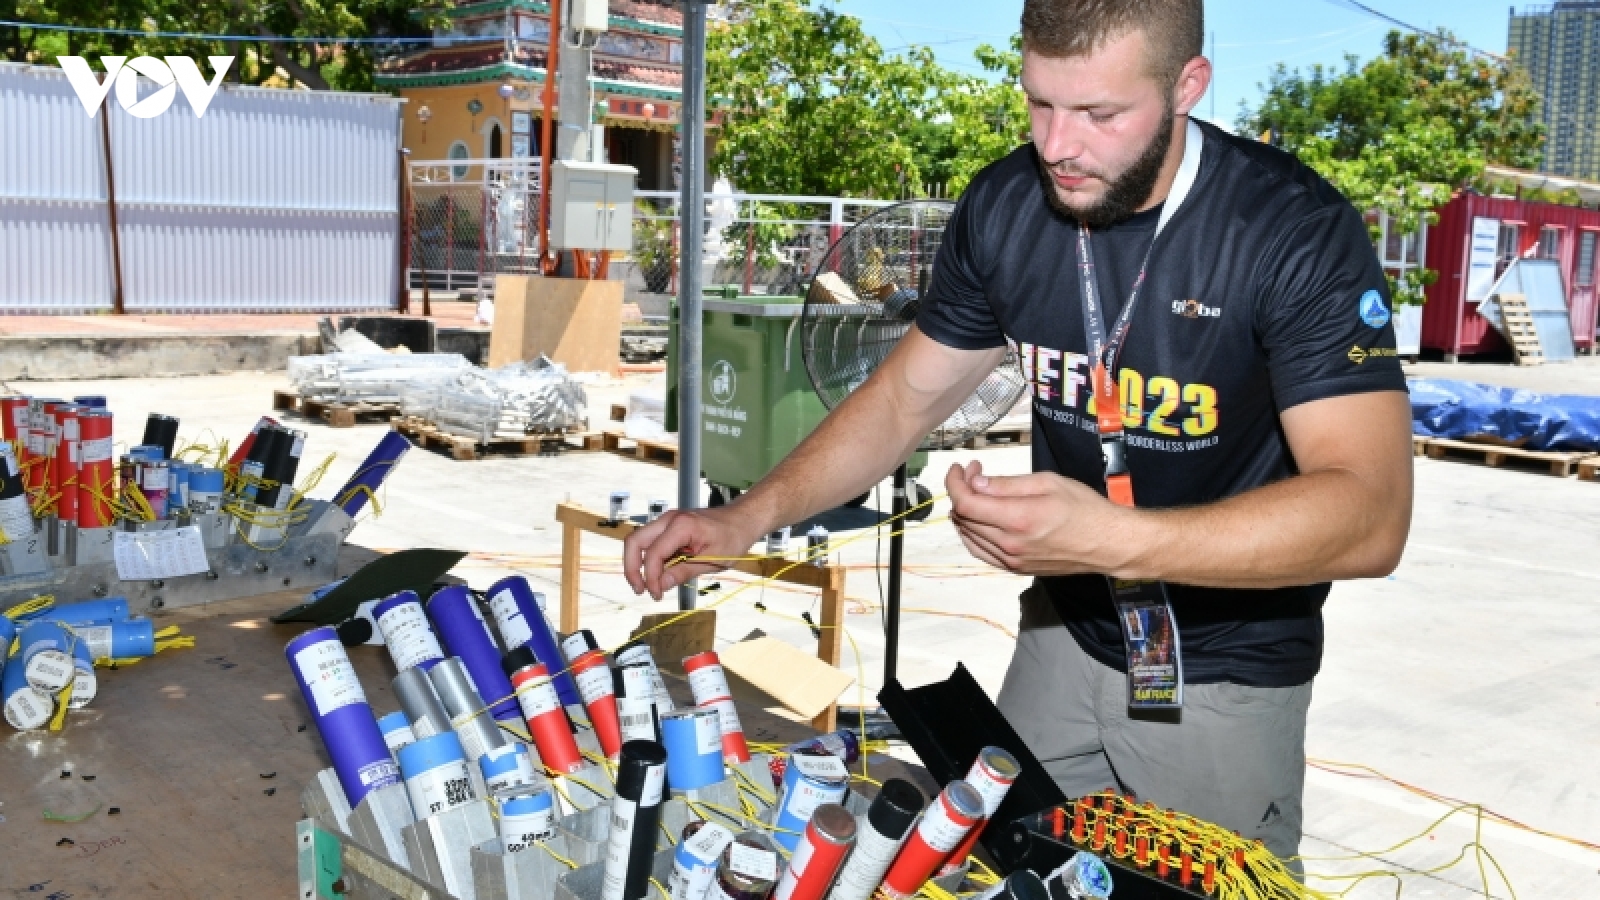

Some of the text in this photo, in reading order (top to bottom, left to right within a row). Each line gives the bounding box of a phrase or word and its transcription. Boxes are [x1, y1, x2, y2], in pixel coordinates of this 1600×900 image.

[1006, 334, 1089, 408] IFF
[1086, 367, 1220, 437] 023
[1185, 435, 1219, 451] WORLD
